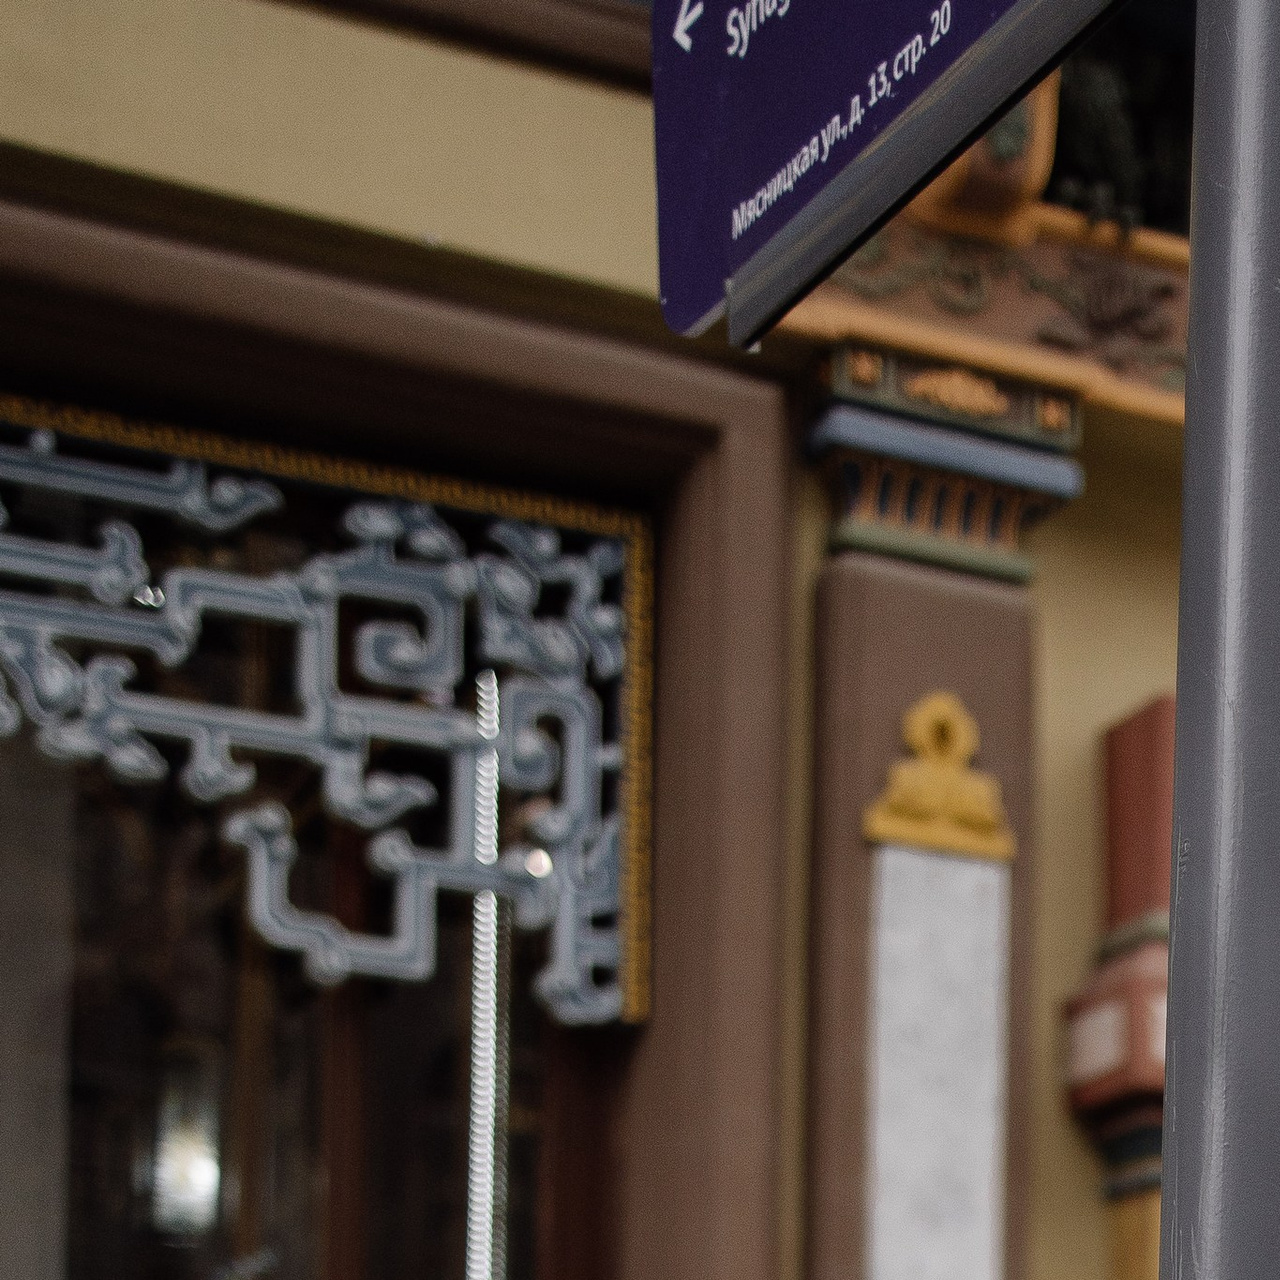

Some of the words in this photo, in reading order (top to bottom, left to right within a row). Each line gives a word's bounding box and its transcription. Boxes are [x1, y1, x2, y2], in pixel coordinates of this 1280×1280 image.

[731, 135, 820, 241] Мясницкая
[848, 93, 866, 134] д.
[867, 60, 892, 108] 13,
[892, 33, 927, 81] стр.
[930, 0, 951, 47] 20
